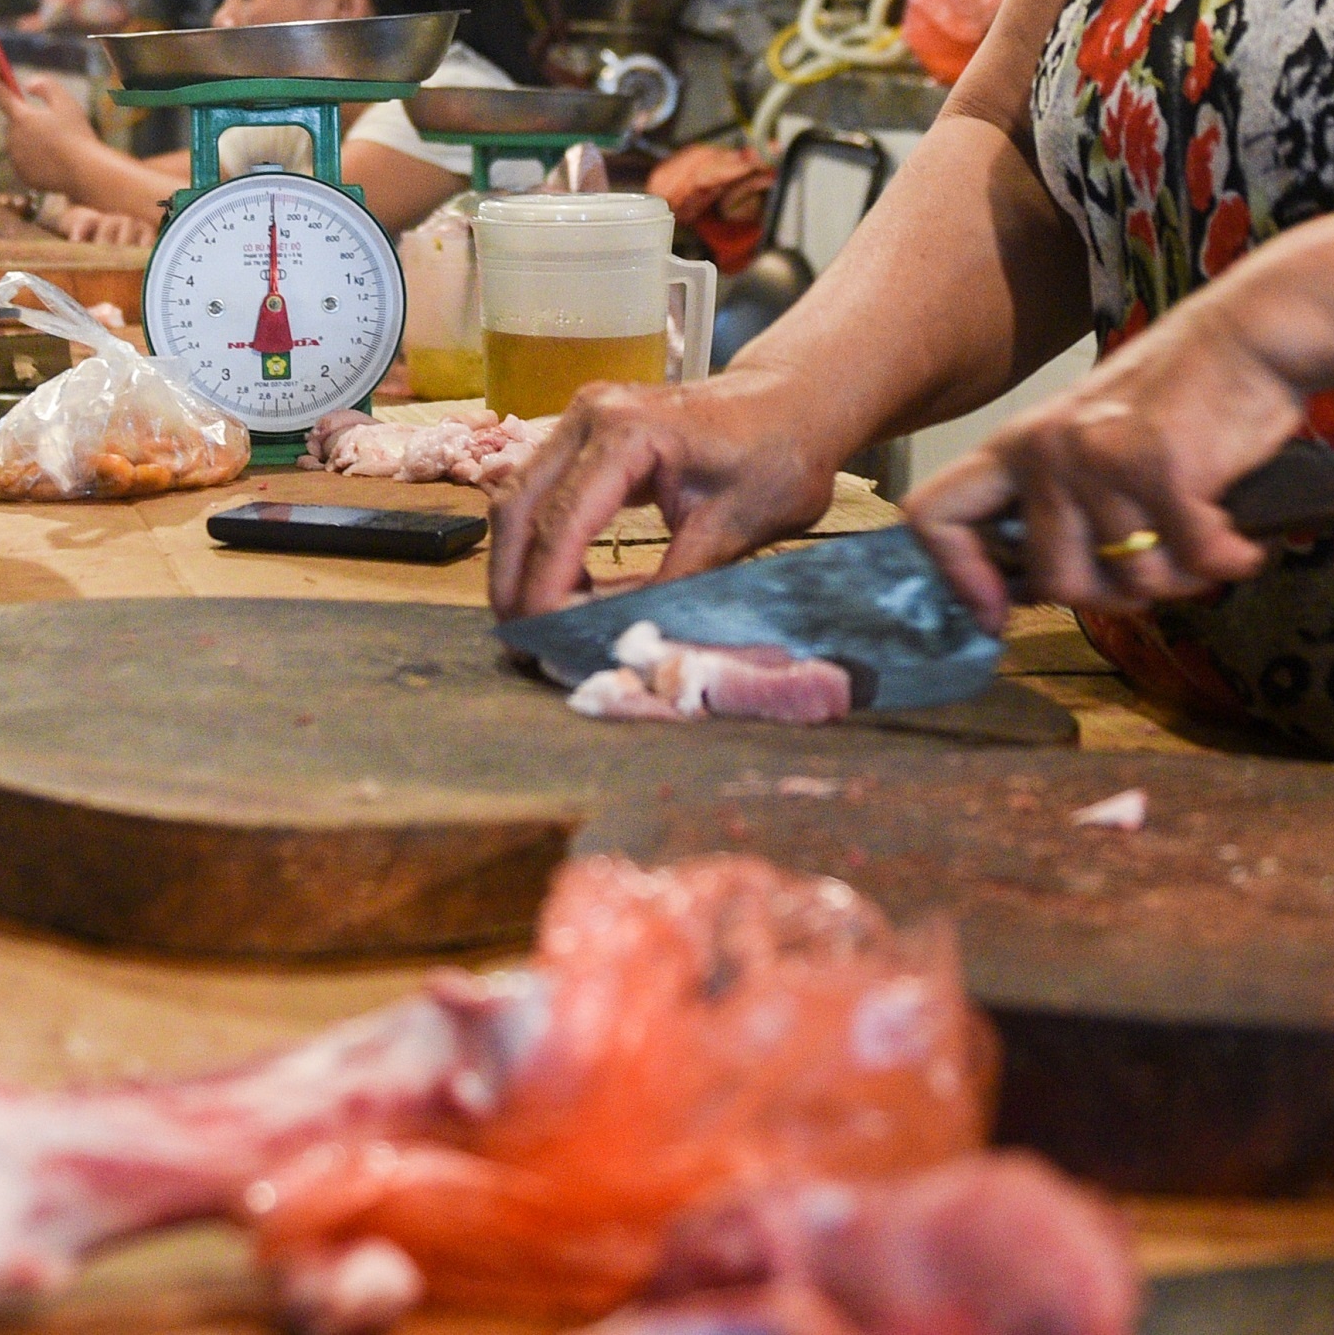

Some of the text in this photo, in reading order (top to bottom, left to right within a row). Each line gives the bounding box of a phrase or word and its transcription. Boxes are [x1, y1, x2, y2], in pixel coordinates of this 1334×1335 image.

[287, 213, 302, 221] 200
[280, 227, 291, 239] kg
[204, 237, 216, 245] 4,4
[340, 252, 355, 260] 800
[186, 275, 195, 287] 4
[345, 272, 365, 286] 1 kg
[357, 293, 369, 301] 1,2
[356, 316, 368, 324] 1,4
[350, 337, 362, 345] 1,6
[187, 341, 200, 350] 3,4
[200, 360, 213, 368] 3,2
[339, 356, 351, 364] 1,8
[221, 368, 231, 381] 3
[320, 364, 330, 378] 2
[303, 384, 316, 393] 2,2
[281, 392, 294, 400] 2,4
